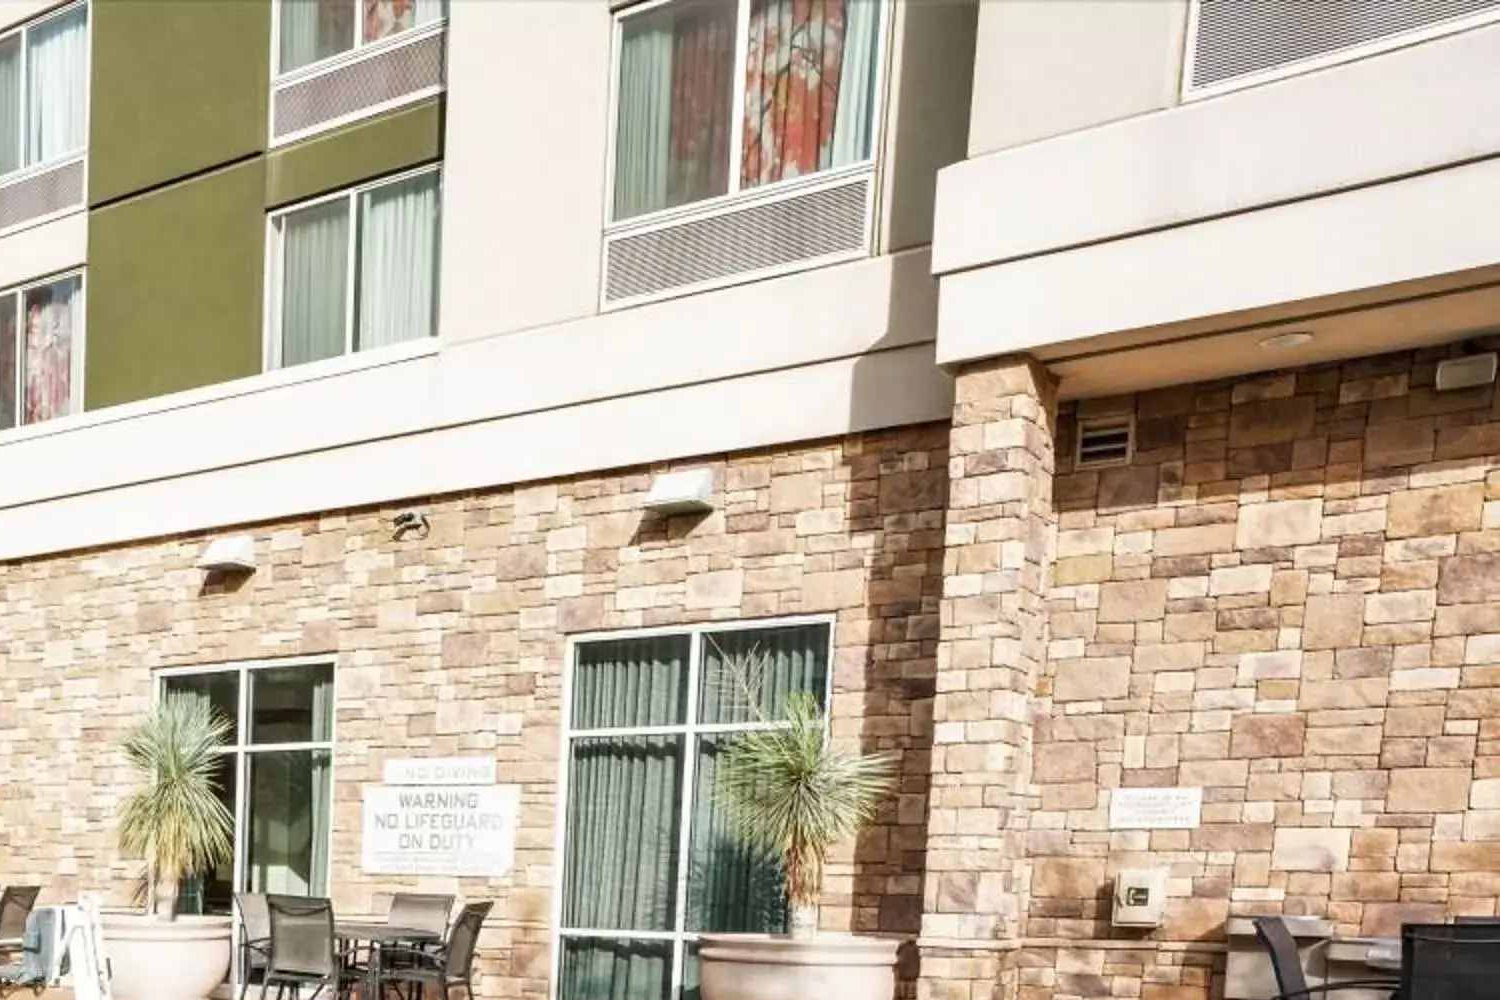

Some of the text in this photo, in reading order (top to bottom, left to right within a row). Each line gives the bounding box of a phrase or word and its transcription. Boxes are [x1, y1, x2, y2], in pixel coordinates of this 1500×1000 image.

[405, 765, 491, 779] NO DIVING
[399, 792, 479, 809] WARNING
[375, 812, 503, 830] NO LIFEGUARD
[398, 833, 476, 850] ON DUTY
